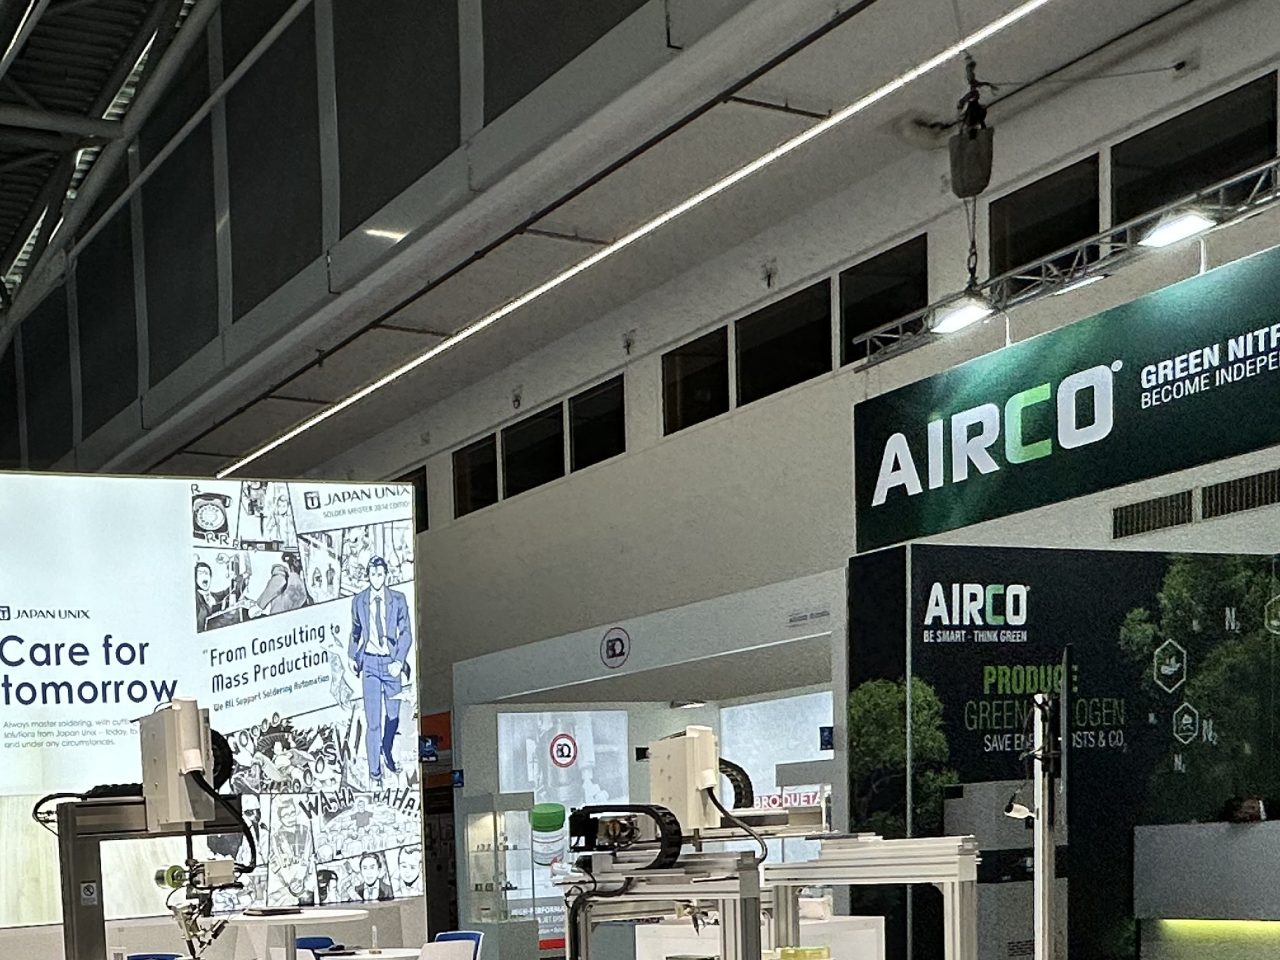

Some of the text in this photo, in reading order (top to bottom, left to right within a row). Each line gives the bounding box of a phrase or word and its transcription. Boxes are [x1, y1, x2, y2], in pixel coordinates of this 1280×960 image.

[1141, 344, 1220, 388] GREEN
[1141, 351, 1280, 409] BECOME INDEPE
[324, 485, 410, 506] JAPAN UNIX
[14, 609, 91, 619] JAPAN UNIX
[251, 624, 326, 656] Consulting
[330, 623, 340, 634] to
[923, 630, 935, 642] BE
[936, 630, 966, 642] SMART
[973, 630, 998, 642] THINK
[1000, 630, 1028, 642] GREEN
[103, 634, 149, 665] for
[2, 674, 178, 705] tomorrow
[212, 672, 249, 693] Mass
[236, 692, 261, 706] Support
[3, 720, 30, 730] Always
[31, 720, 56, 728] master
[37, 730, 54, 738] from
[56, 730, 80, 738] Japan
[82, 729, 96, 737] Unix
[22, 739, 44, 748] under
[46, 740, 59, 748] any
[984, 734, 1011, 752] SAVE
